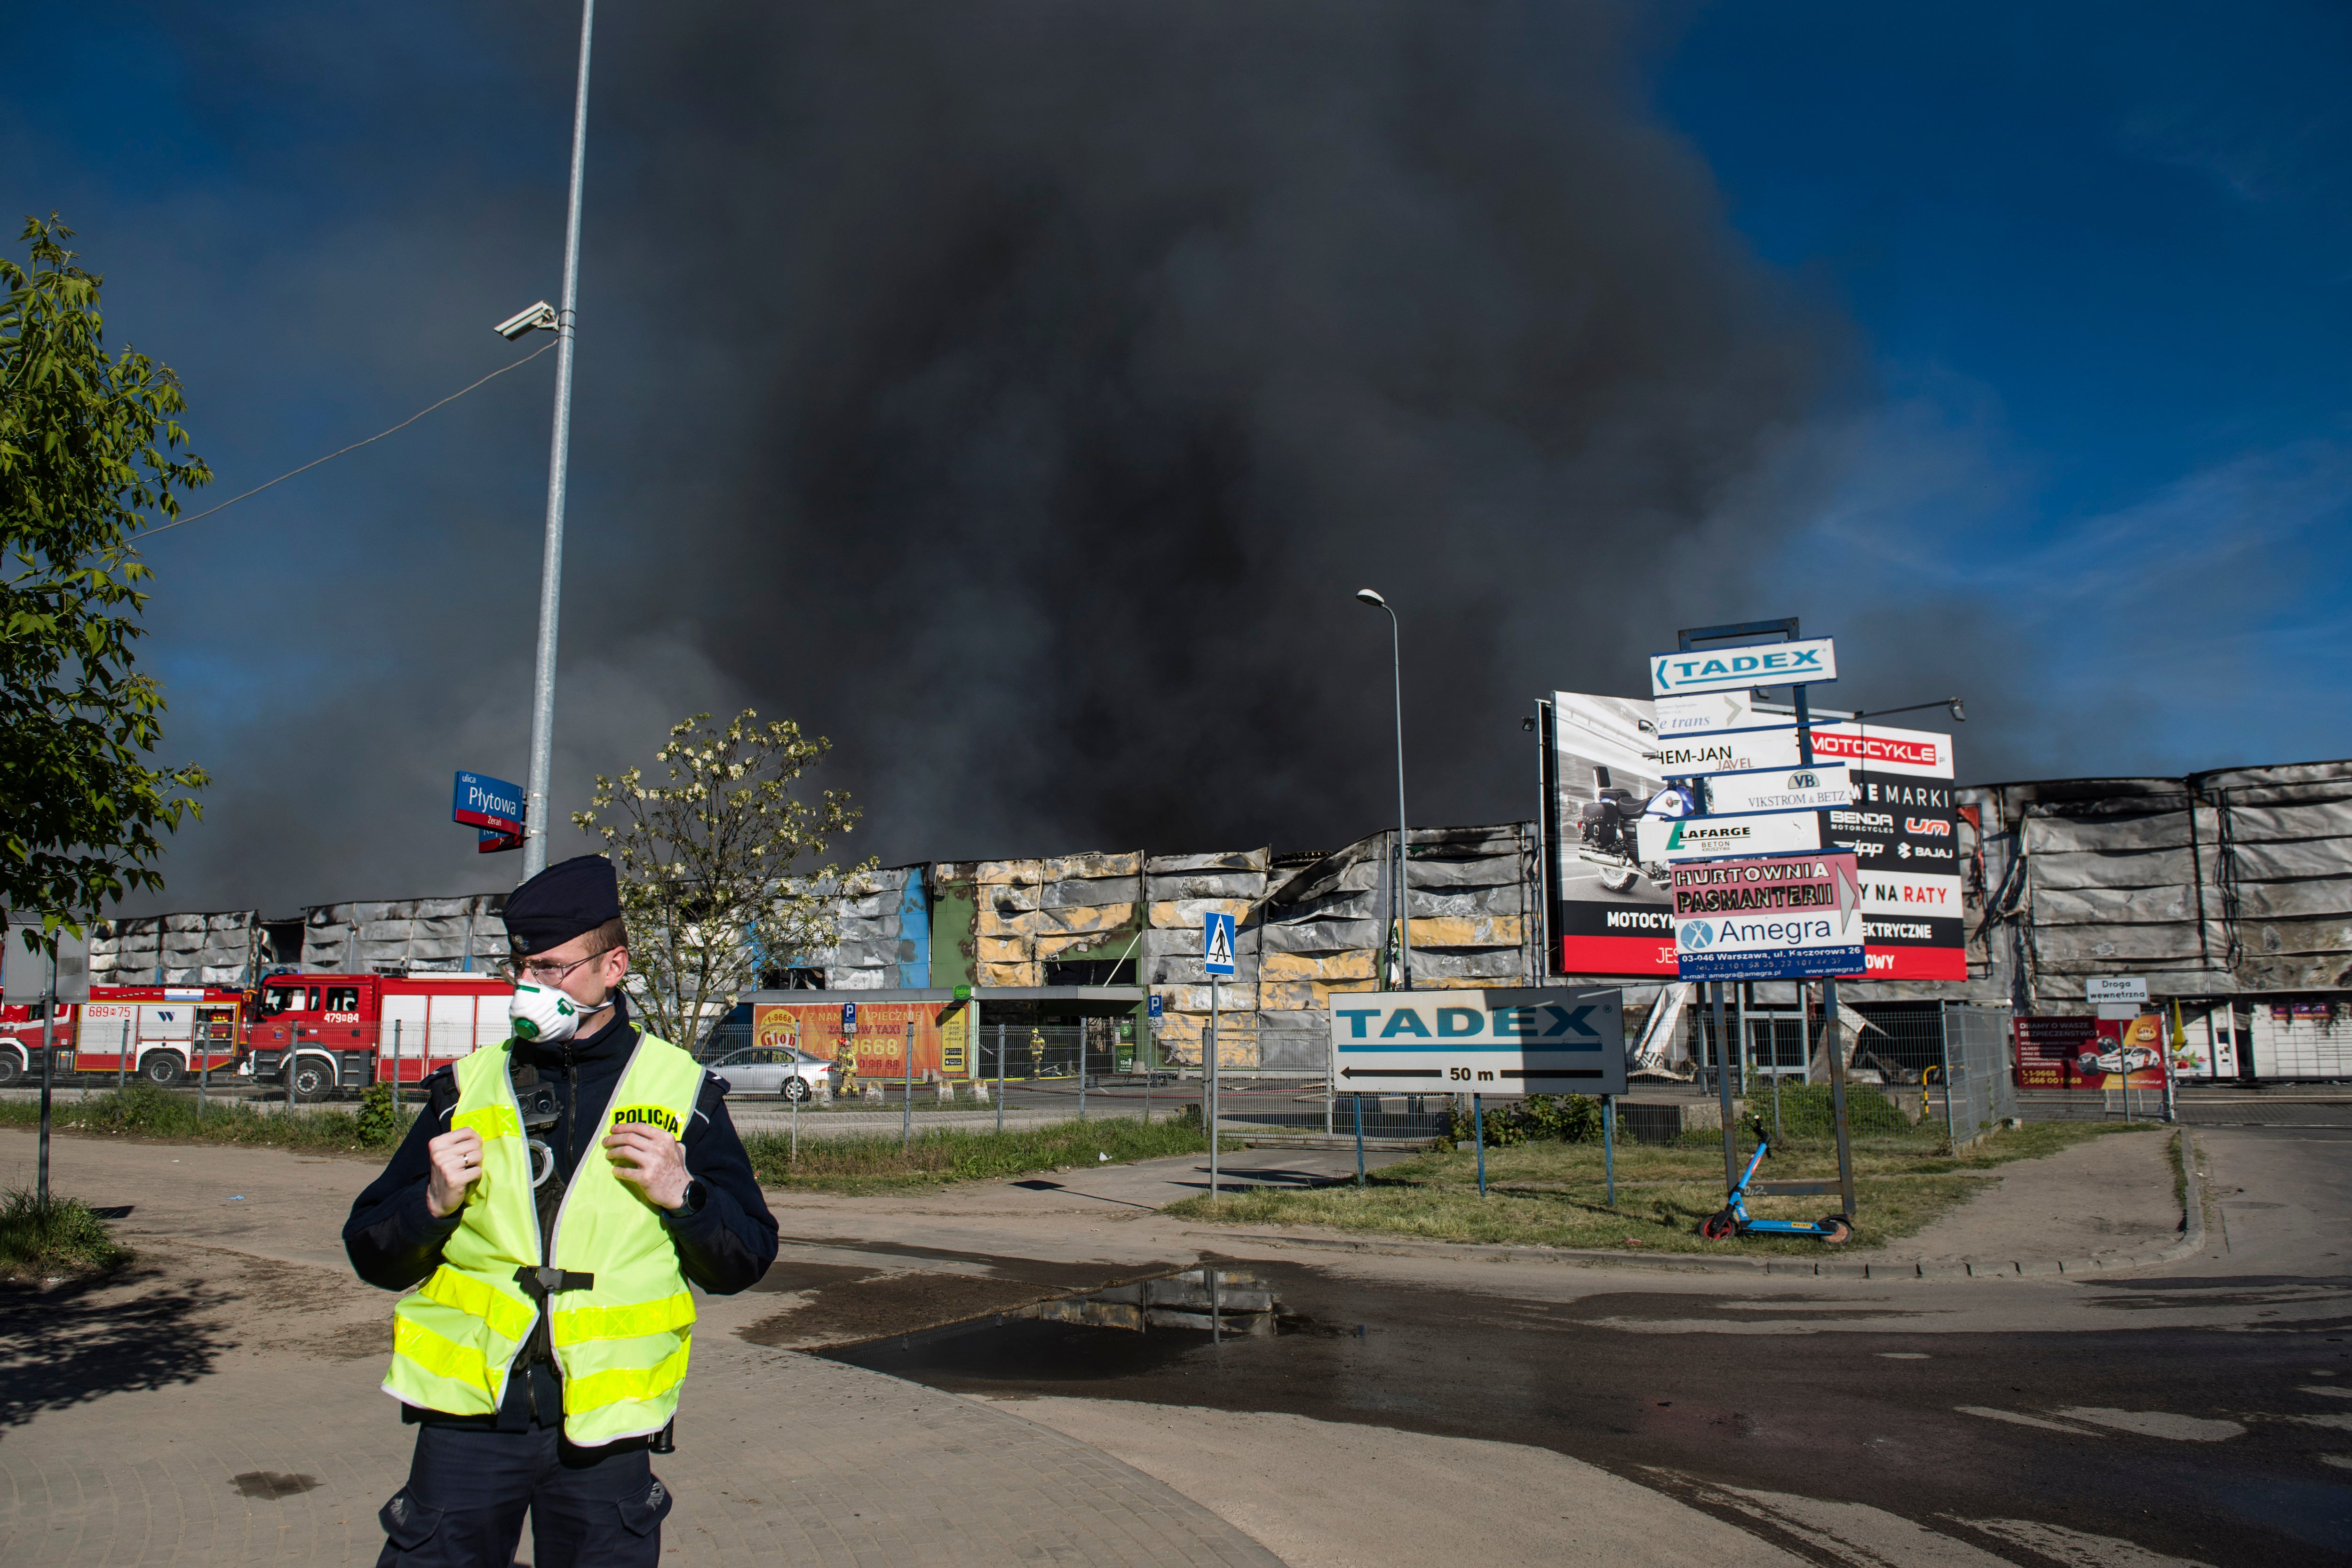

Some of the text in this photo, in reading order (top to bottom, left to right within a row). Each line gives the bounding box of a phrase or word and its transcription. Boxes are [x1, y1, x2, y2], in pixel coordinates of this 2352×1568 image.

[1674, 649, 1820, 677] TADEX
[1672, 716, 1710, 728] trans
[1810, 735, 1935, 762] MOTOCYKLE
[1716, 758, 1755, 771] JAVEL
[462, 774, 476, 784] ulica
[1794, 774, 1815, 788] VB
[469, 786, 516, 815] Płytowa
[1748, 795, 1806, 808] VIKSTROM
[1817, 791, 1846, 803] BETZ
[1885, 785, 1949, 808] MARKI
[487, 814, 501, 826] Żerań
[1830, 811, 1893, 827] BENDA
[1679, 827, 1750, 839] LAFARGE
[1830, 824, 1894, 834] MOTORCYCLES
[1915, 846, 1953, 859] BAJAJ
[1675, 862, 1830, 886] HURTOWNIA
[1677, 883, 1834, 914] PASMANTERII
[1875, 884, 1898, 901] NA
[1904, 886, 1947, 904] RATY
[1607, 911, 1676, 929] MOTOCYK
[1719, 919, 1831, 945] Amegra
[1788, 948, 1845, 957] Kaczorowa
[1708, 970, 1781, 979] amegra@amegra.pl
[1804, 966, 1863, 974] www.amegra.pl
[2102, 980, 2131, 989] Droga
[2090, 991, 2145, 1000] wewnętrzna
[1152, 997, 1160, 1011] P
[767, 1013, 793, 1023] 1-9668
[809, 1012, 815, 1022] Z
[858, 1011, 922, 1021] EZPIECZNIE
[847, 1005, 854, 1018] P
[1335, 1005, 1601, 1038] TADEX
[875, 1025, 901, 1035] TAXI
[829, 1038, 898, 1055] 19668
[1450, 1067, 1494, 1081] 50 m
[615, 1108, 678, 1133] POLICJA
